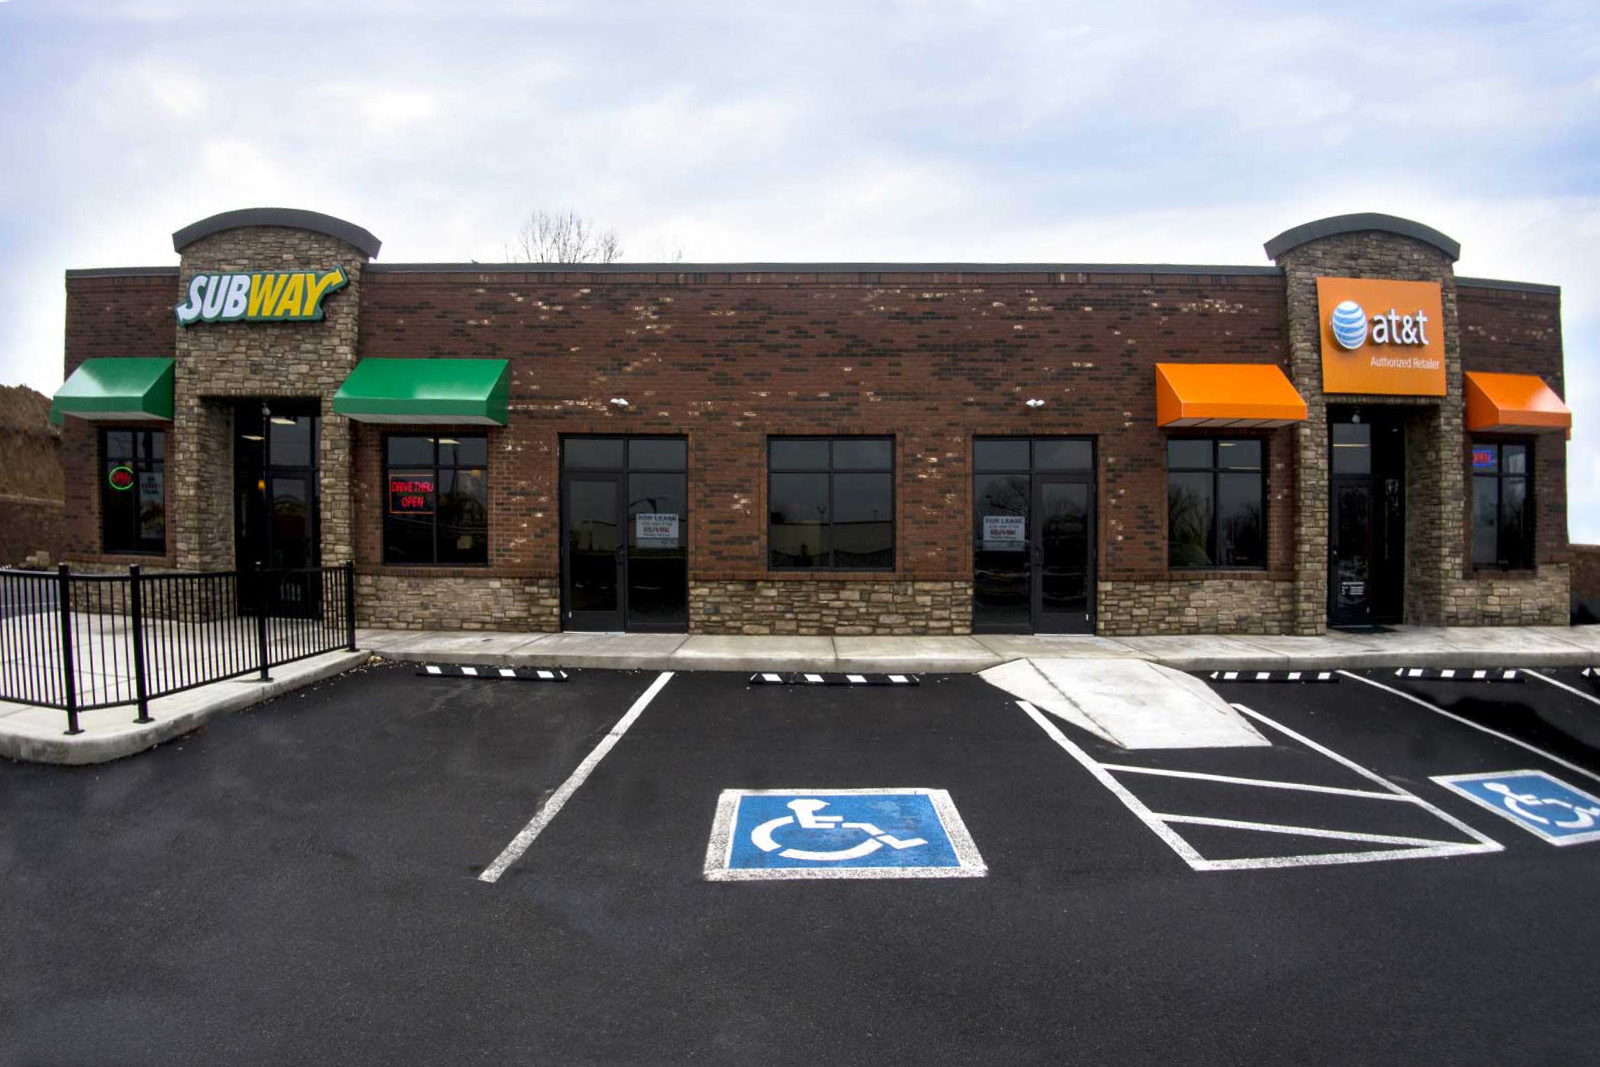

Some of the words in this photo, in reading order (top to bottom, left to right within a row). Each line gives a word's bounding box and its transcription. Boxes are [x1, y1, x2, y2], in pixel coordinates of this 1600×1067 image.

[177, 268, 343, 321] SUBWAY
[1372, 308, 1429, 345] at&t
[1371, 356, 1411, 368] Authorized
[1412, 358, 1440, 369] Retailer
[391, 481, 412, 492] DRIVE
[413, 481, 434, 492] THRU
[401, 496, 424, 508] OPEN
